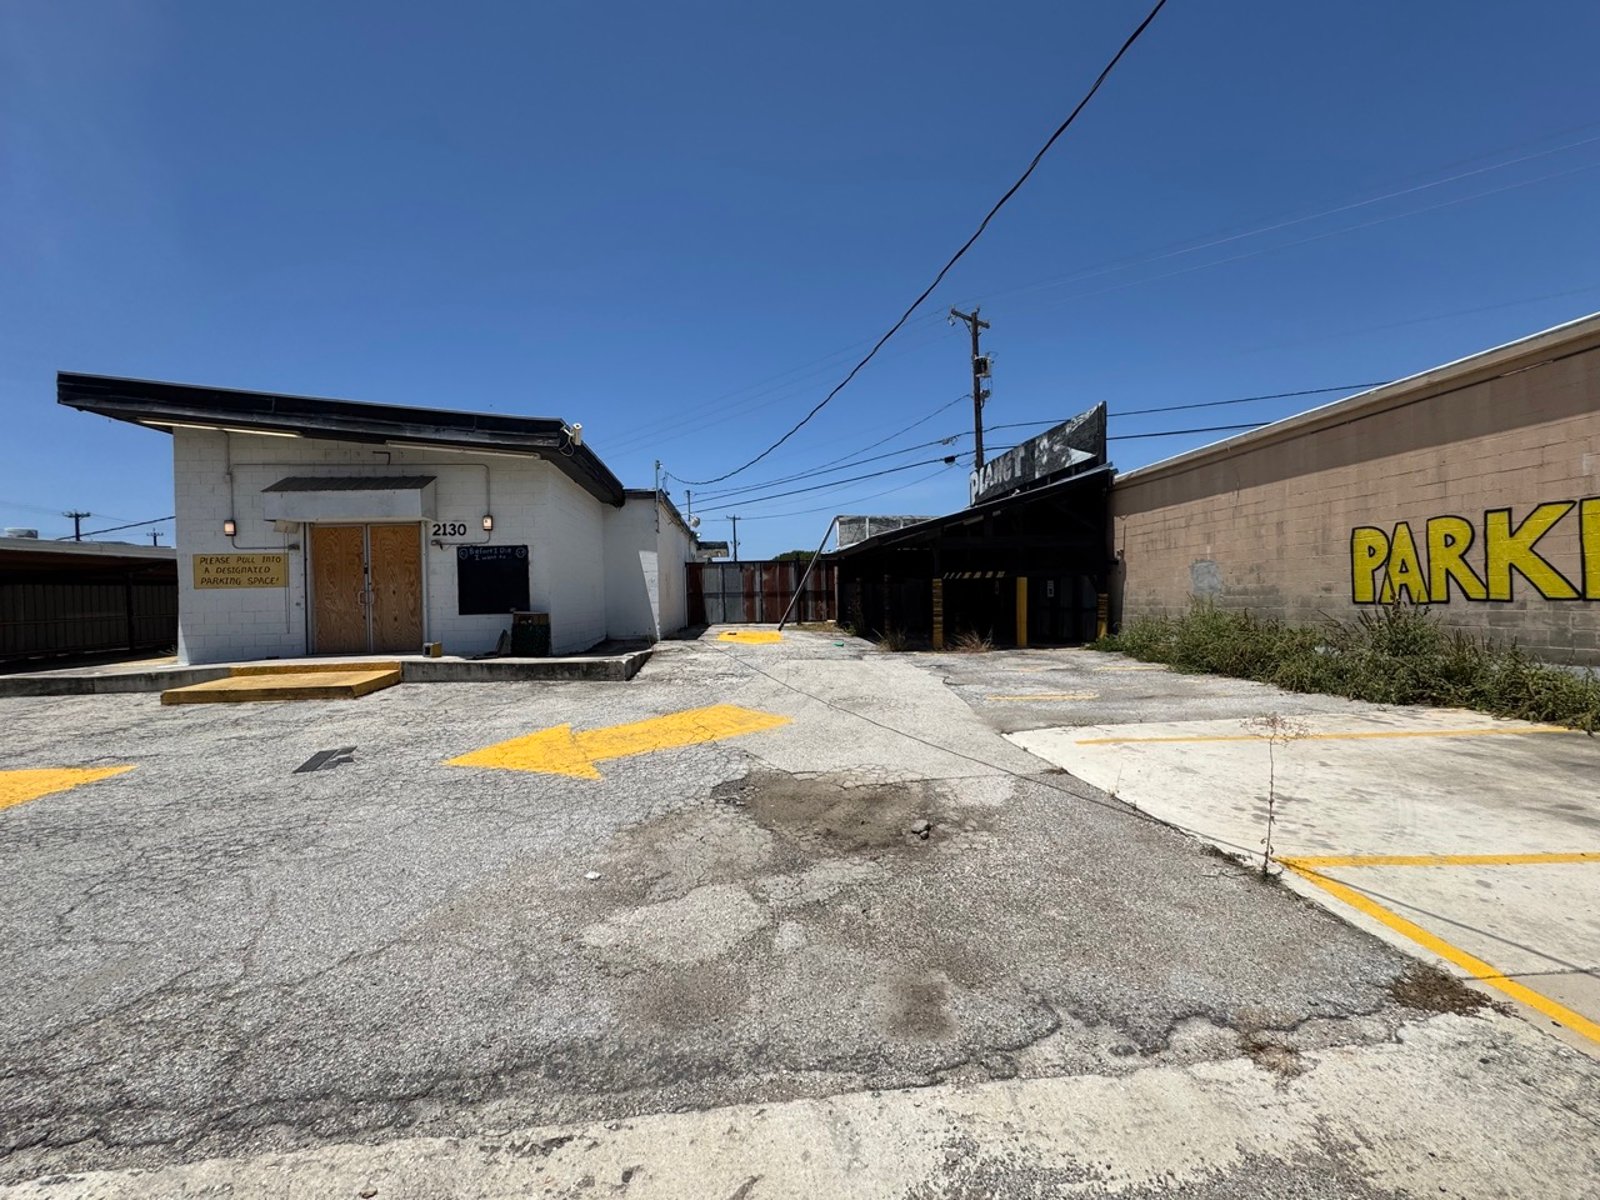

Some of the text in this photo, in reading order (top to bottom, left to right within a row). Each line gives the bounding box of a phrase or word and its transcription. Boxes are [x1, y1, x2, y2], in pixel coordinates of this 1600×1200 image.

[432, 523, 467, 536] 2130
[200, 555, 282, 565] PLEASE PULL INTO
[216, 566, 271, 574] DESIGNATED
[201, 576, 242, 585] PARKING
